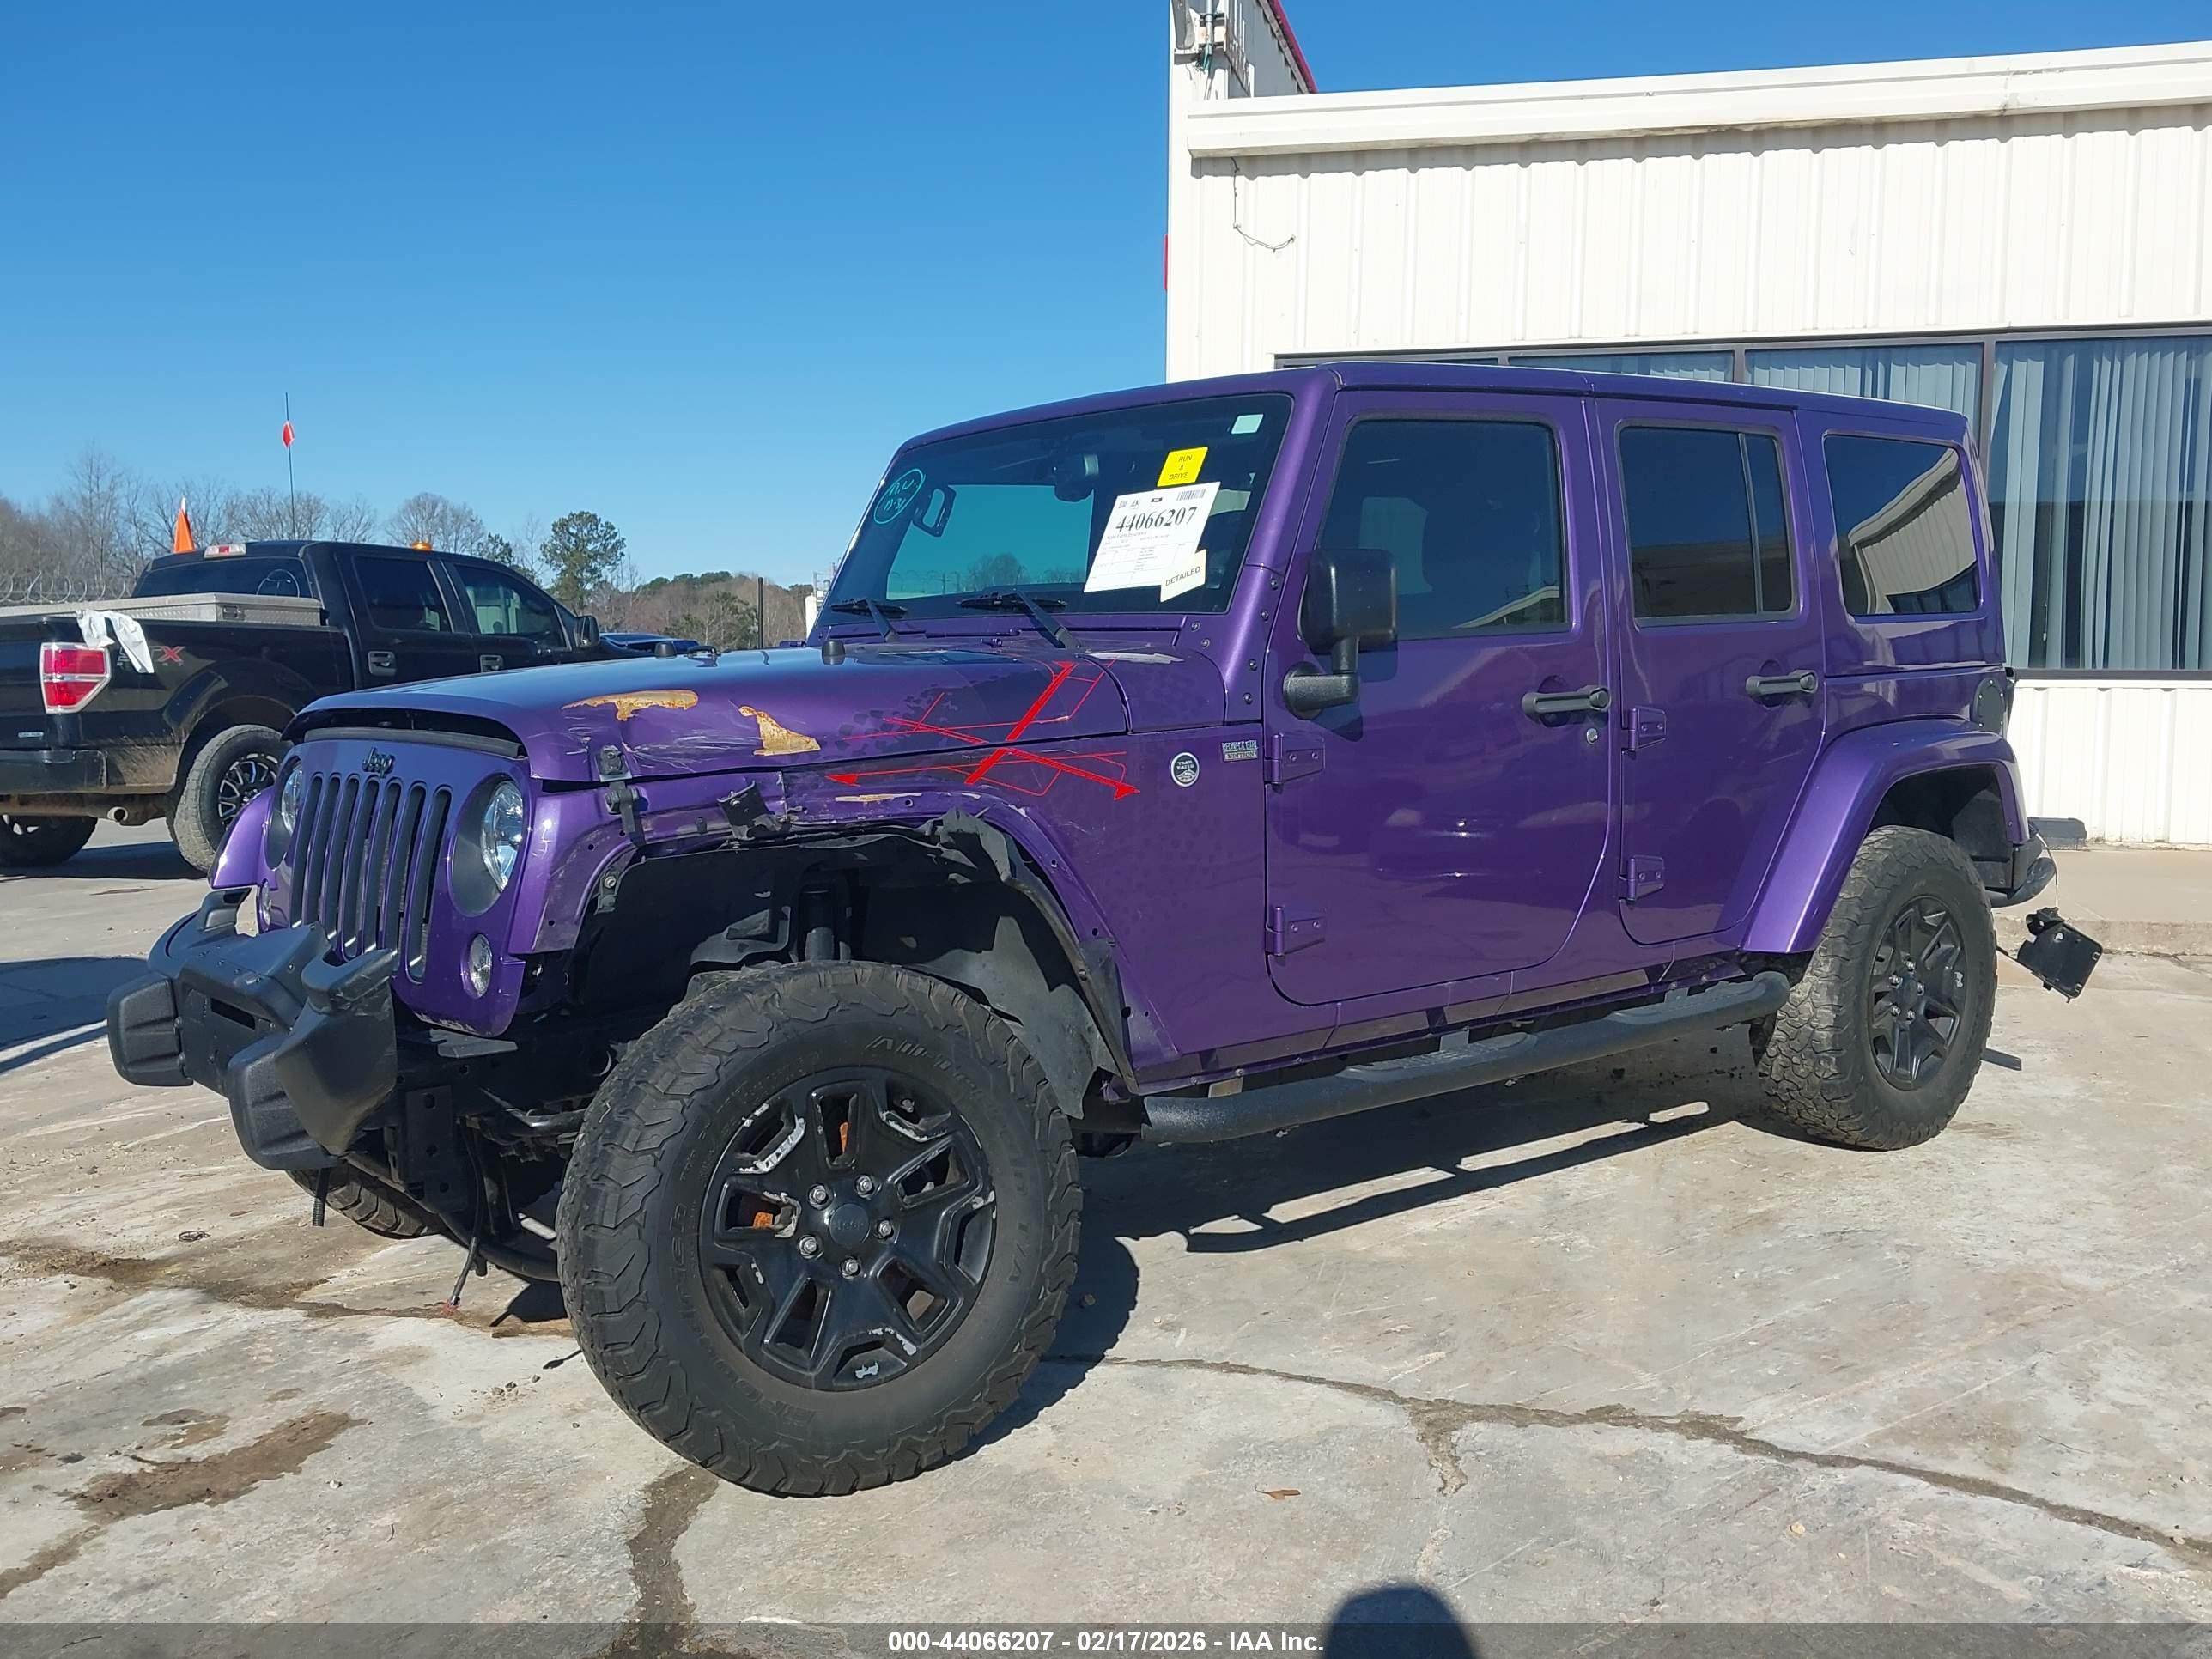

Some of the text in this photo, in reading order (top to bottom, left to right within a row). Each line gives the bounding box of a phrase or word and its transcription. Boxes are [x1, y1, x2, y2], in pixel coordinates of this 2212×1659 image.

[1169, 471, 1189, 480] DRIVE
[1115, 506, 1198, 532] 44066207
[1165, 566, 1201, 586] DETAILED
